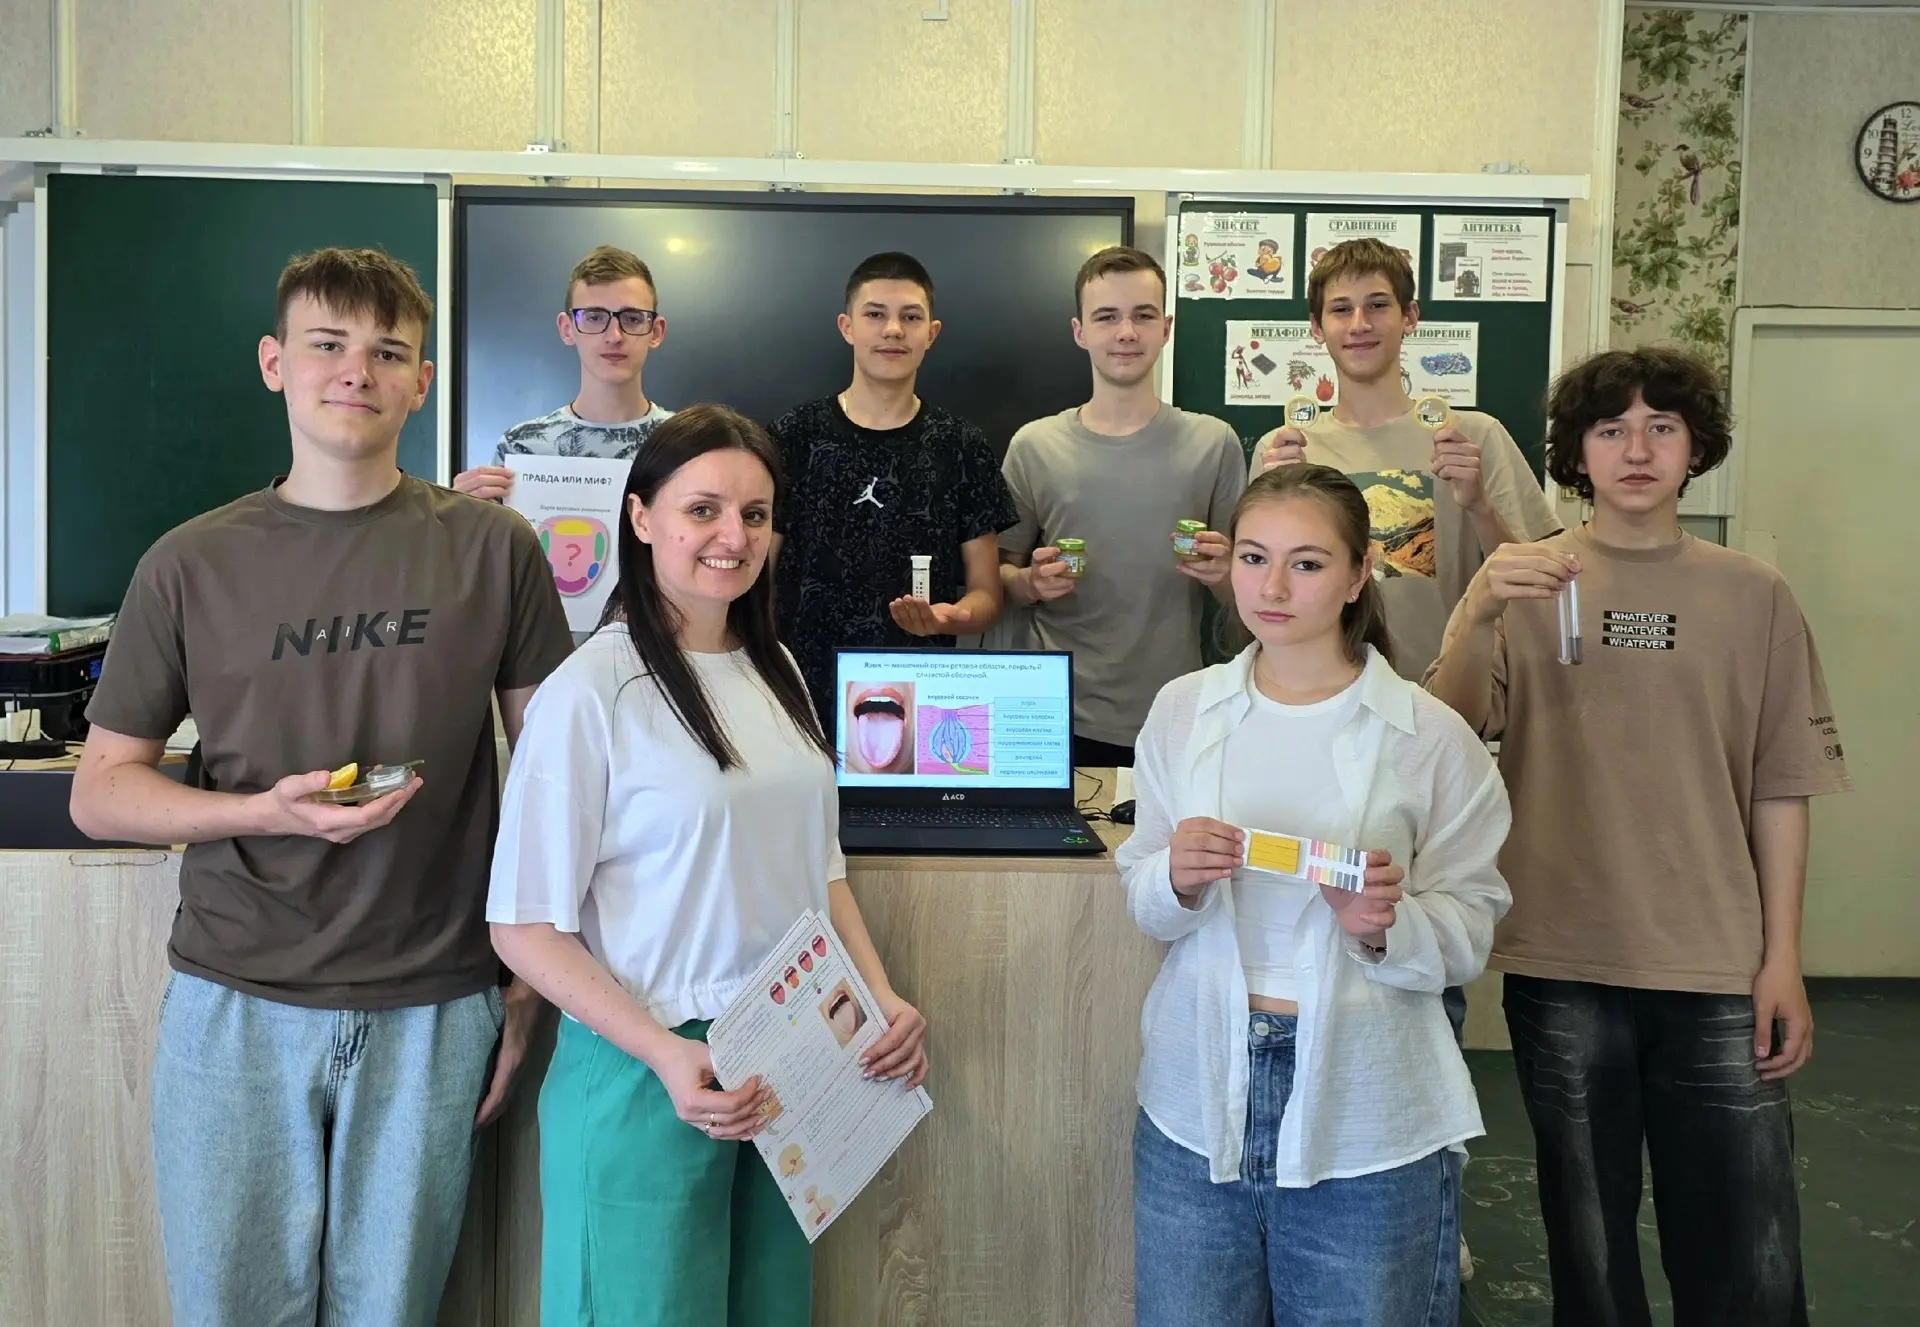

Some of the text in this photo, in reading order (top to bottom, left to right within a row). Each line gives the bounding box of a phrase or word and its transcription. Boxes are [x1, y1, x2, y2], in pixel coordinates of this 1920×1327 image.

[1901, 107, 1912, 118] 12
[1868, 129, 1879, 139] 10
[1864, 148, 1872, 159] 9
[1329, 221, 1397, 231] СРАВНЕНИЕ
[1461, 223, 1521, 233] АНТИТЕЗА
[523, 473, 612, 486] ПРАВДА ИЛИ МИФ?
[1611, 612, 1669, 623] WHATEVER
[272, 609, 431, 660] NIKE
[1610, 624, 1668, 635] WHATEVER
[1608, 637, 1667, 649] WHATEVER
[950, 793, 966, 801] ACD
